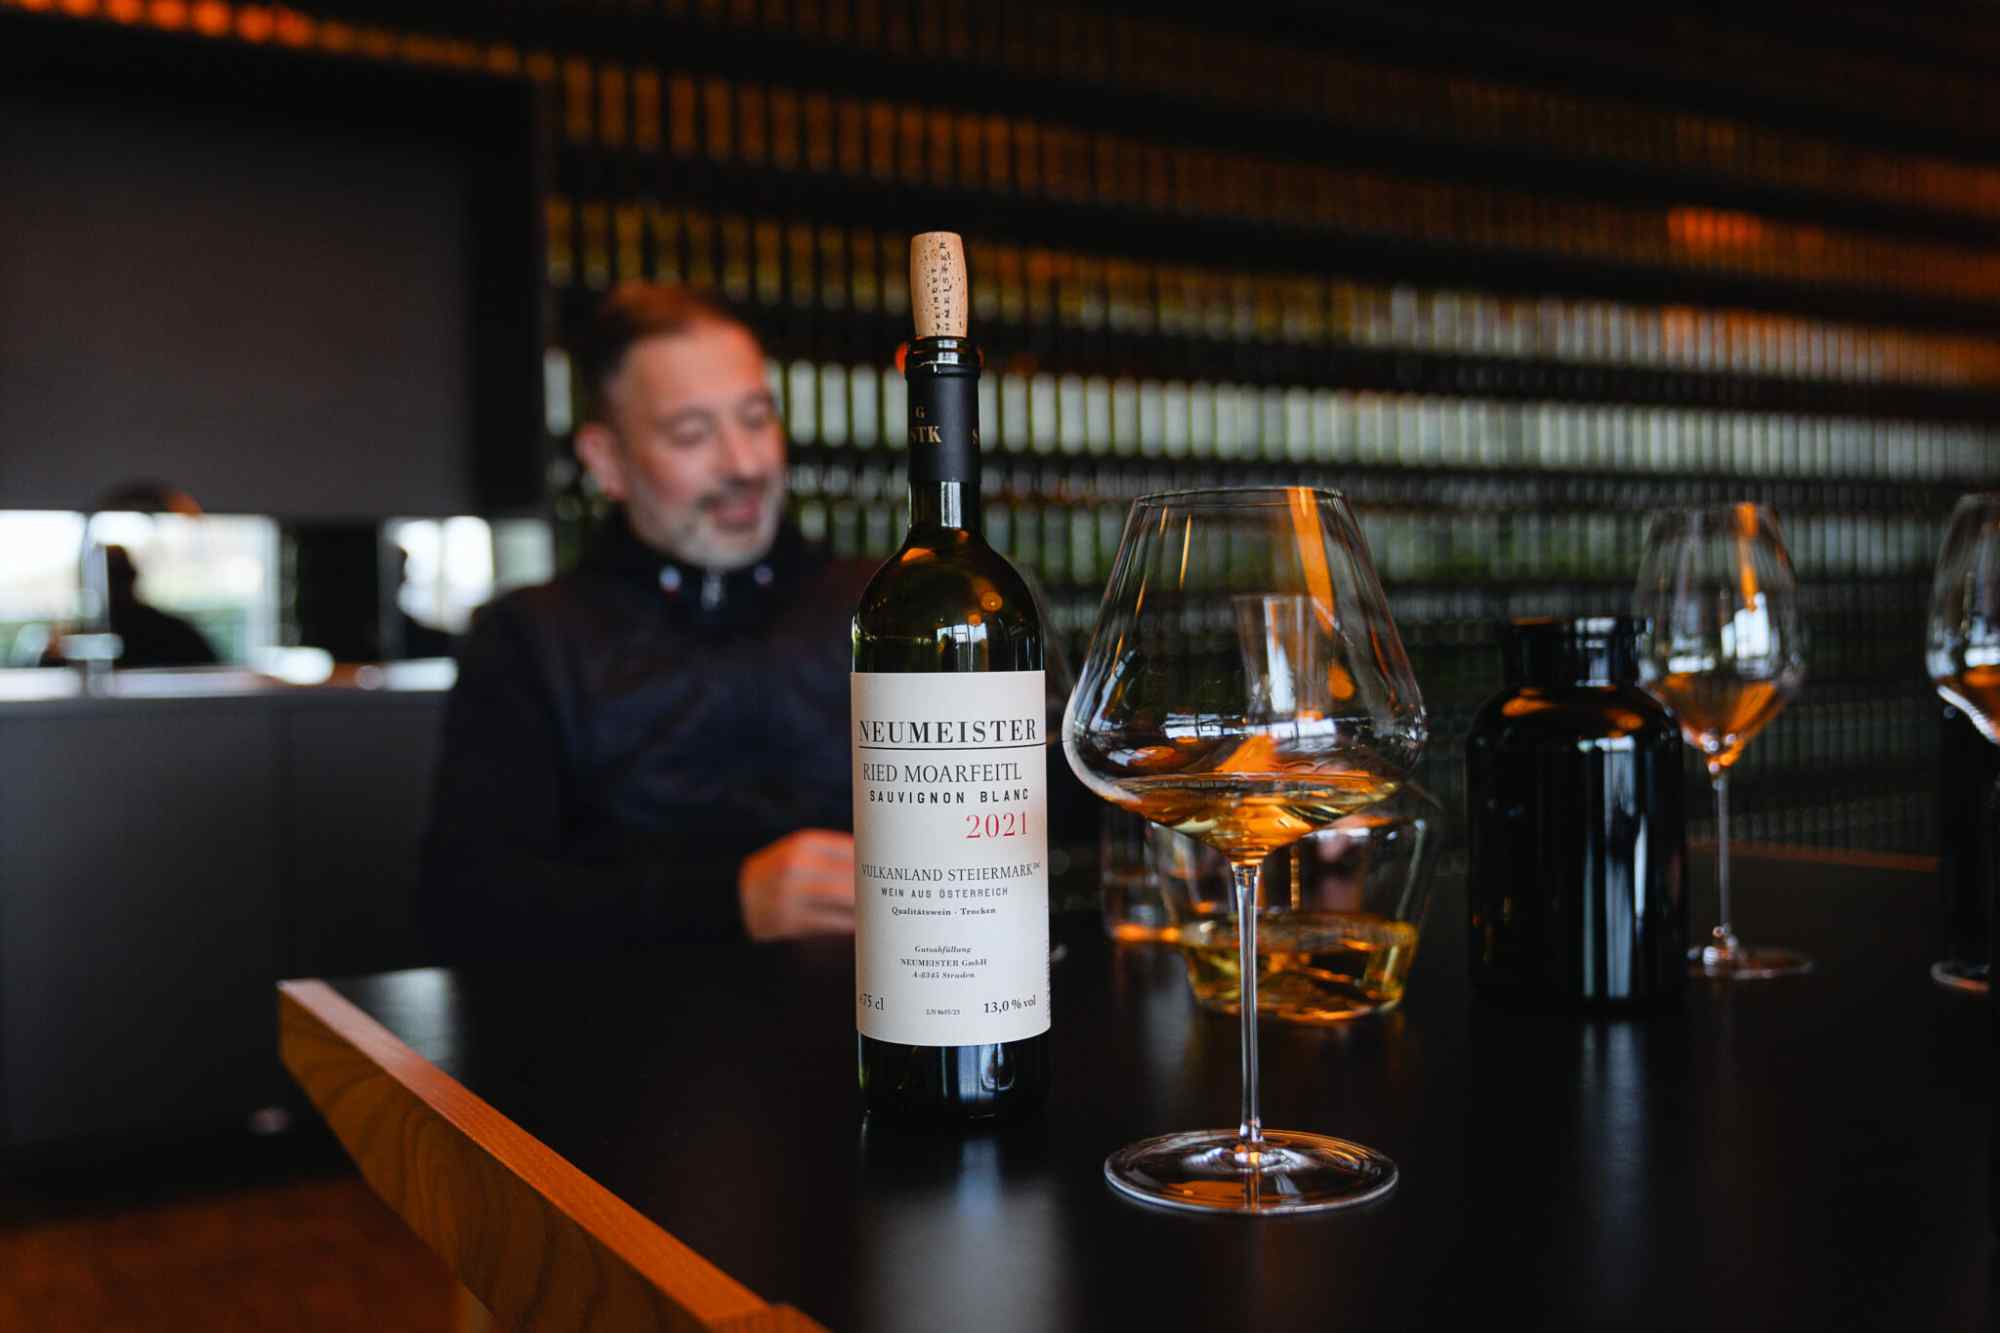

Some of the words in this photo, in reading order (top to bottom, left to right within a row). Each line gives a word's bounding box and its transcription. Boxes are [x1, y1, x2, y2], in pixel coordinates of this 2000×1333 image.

[859, 718, 1037, 744] NEUMEISTER
[863, 762, 898, 783] RIED
[903, 762, 1023, 784] MOARFEITL
[870, 790, 965, 804] SAUVIGNON
[980, 788, 1029, 803] BLANC
[965, 811, 1028, 839] 2021
[862, 863, 943, 882] VULKANLAND
[881, 887, 904, 898] WEIN
[911, 889, 931, 899] AUS
[891, 906, 951, 917] Qualitätswein
[960, 907, 996, 916] Trocken
[899, 958, 959, 968] NEUMEISTER
[984, 1000, 1009, 1014] 13,0
[1023, 994, 1036, 1007] vol
